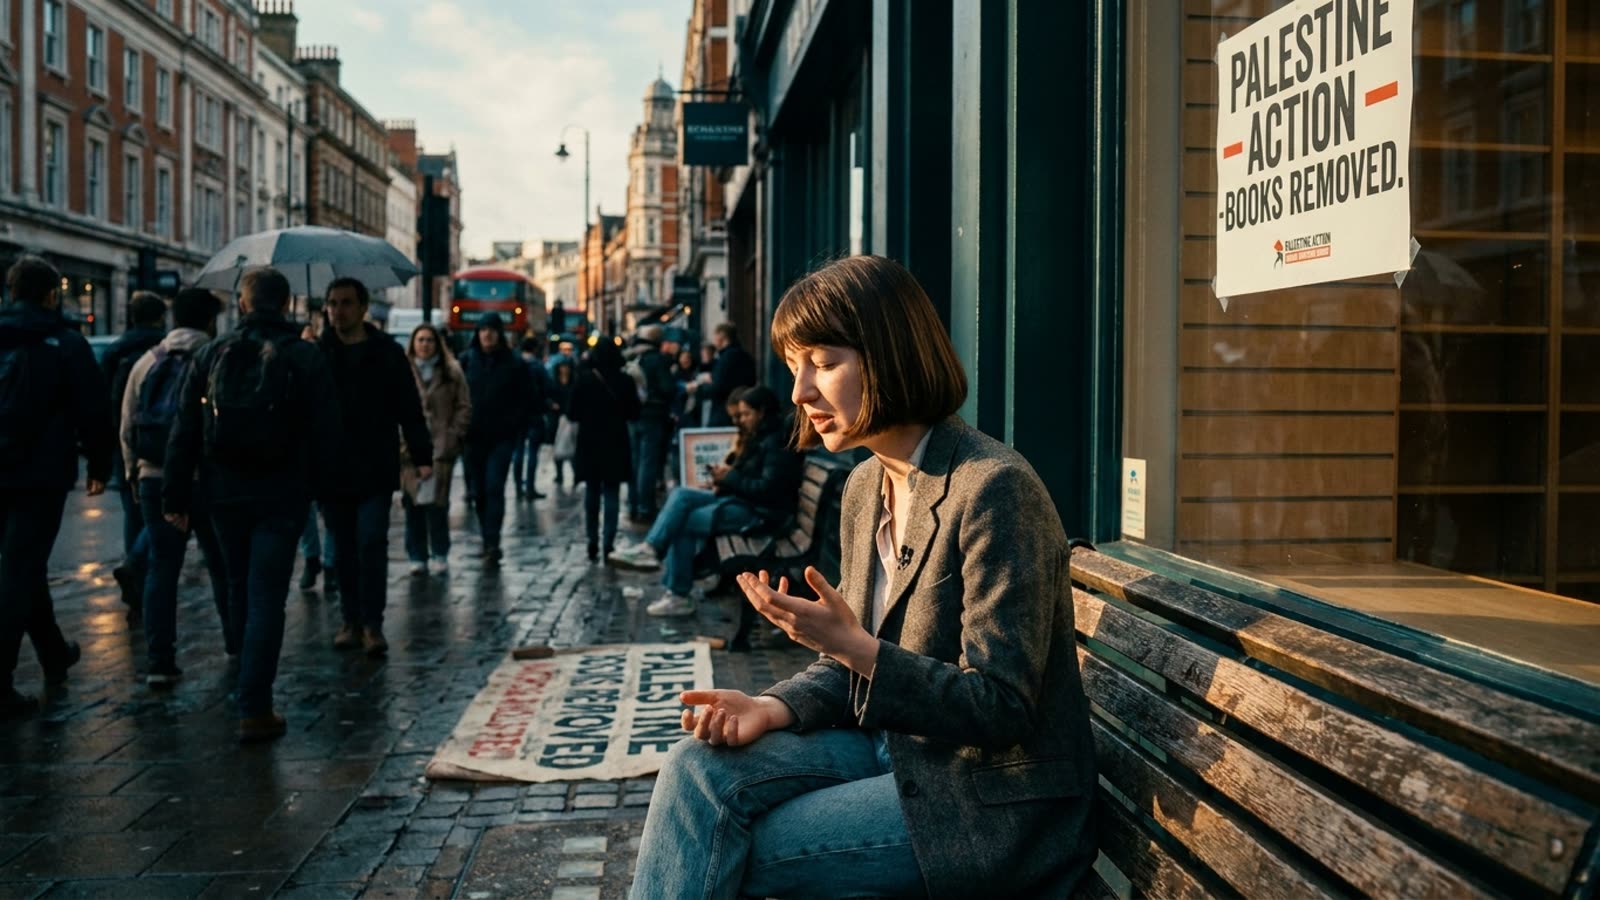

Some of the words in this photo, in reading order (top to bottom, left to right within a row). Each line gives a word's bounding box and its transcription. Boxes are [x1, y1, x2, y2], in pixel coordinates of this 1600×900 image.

[1231, 0, 1392, 114] PALESTINE
[1248, 70, 1355, 175] ACTION
[1290, 140, 1403, 216] REMOVED.
[627, 649, 695, 755] PALESTINE
